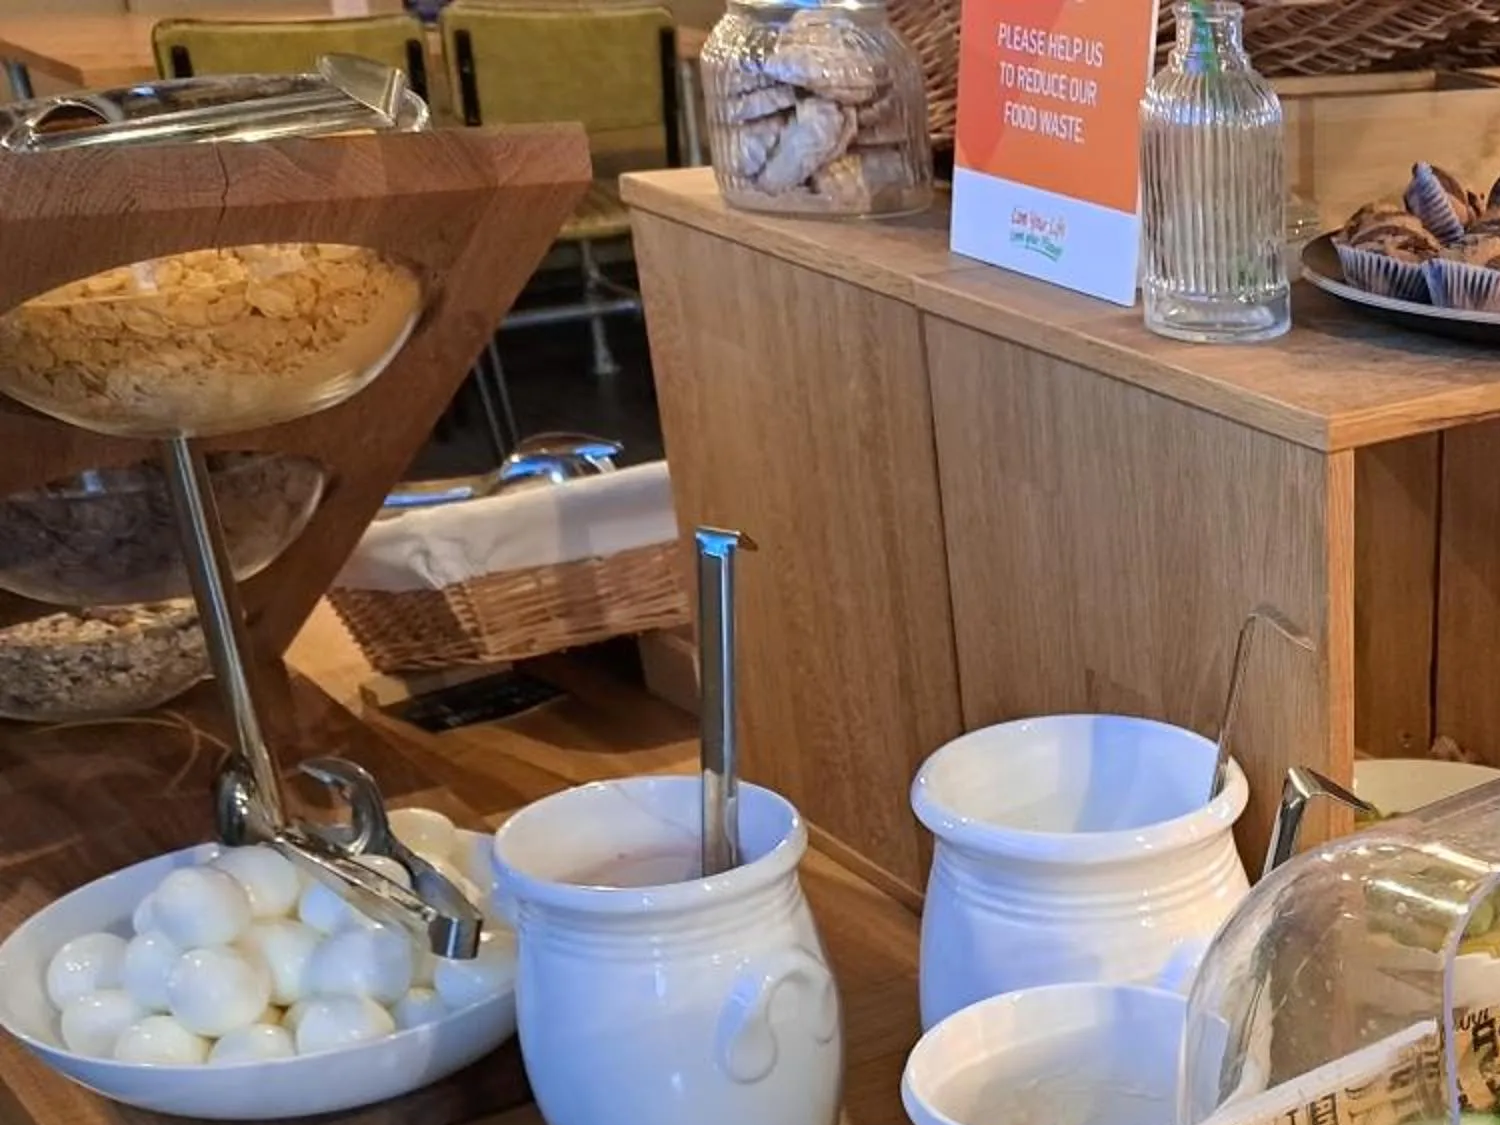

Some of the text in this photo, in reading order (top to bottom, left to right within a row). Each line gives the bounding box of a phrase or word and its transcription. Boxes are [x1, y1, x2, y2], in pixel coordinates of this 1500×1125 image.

[997, 22, 1105, 68] PLEASE HELP US
[999, 61, 1098, 108] TO REDUCE OUR
[1003, 100, 1038, 132] FOOD
